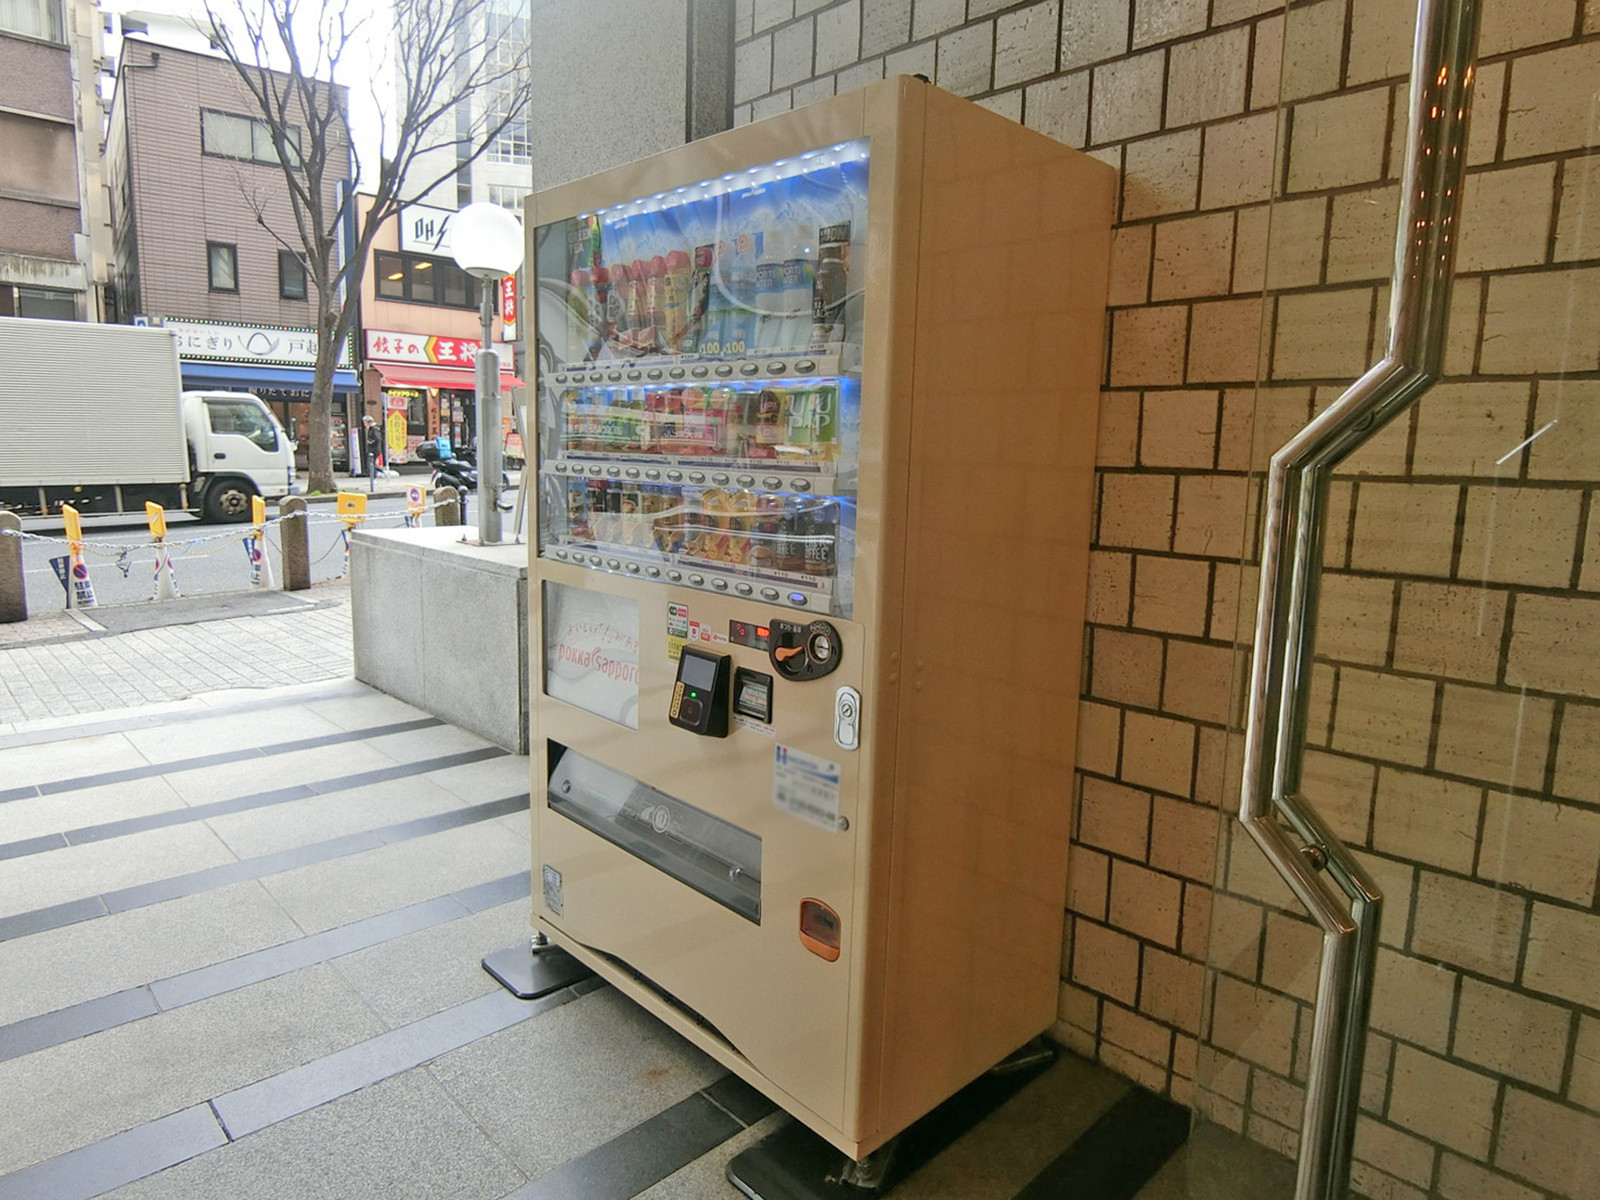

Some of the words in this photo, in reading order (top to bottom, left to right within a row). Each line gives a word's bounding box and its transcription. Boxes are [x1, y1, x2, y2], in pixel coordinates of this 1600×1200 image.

[503, 280, 515, 316] 王将
[373, 336, 420, 355] 餃子の
